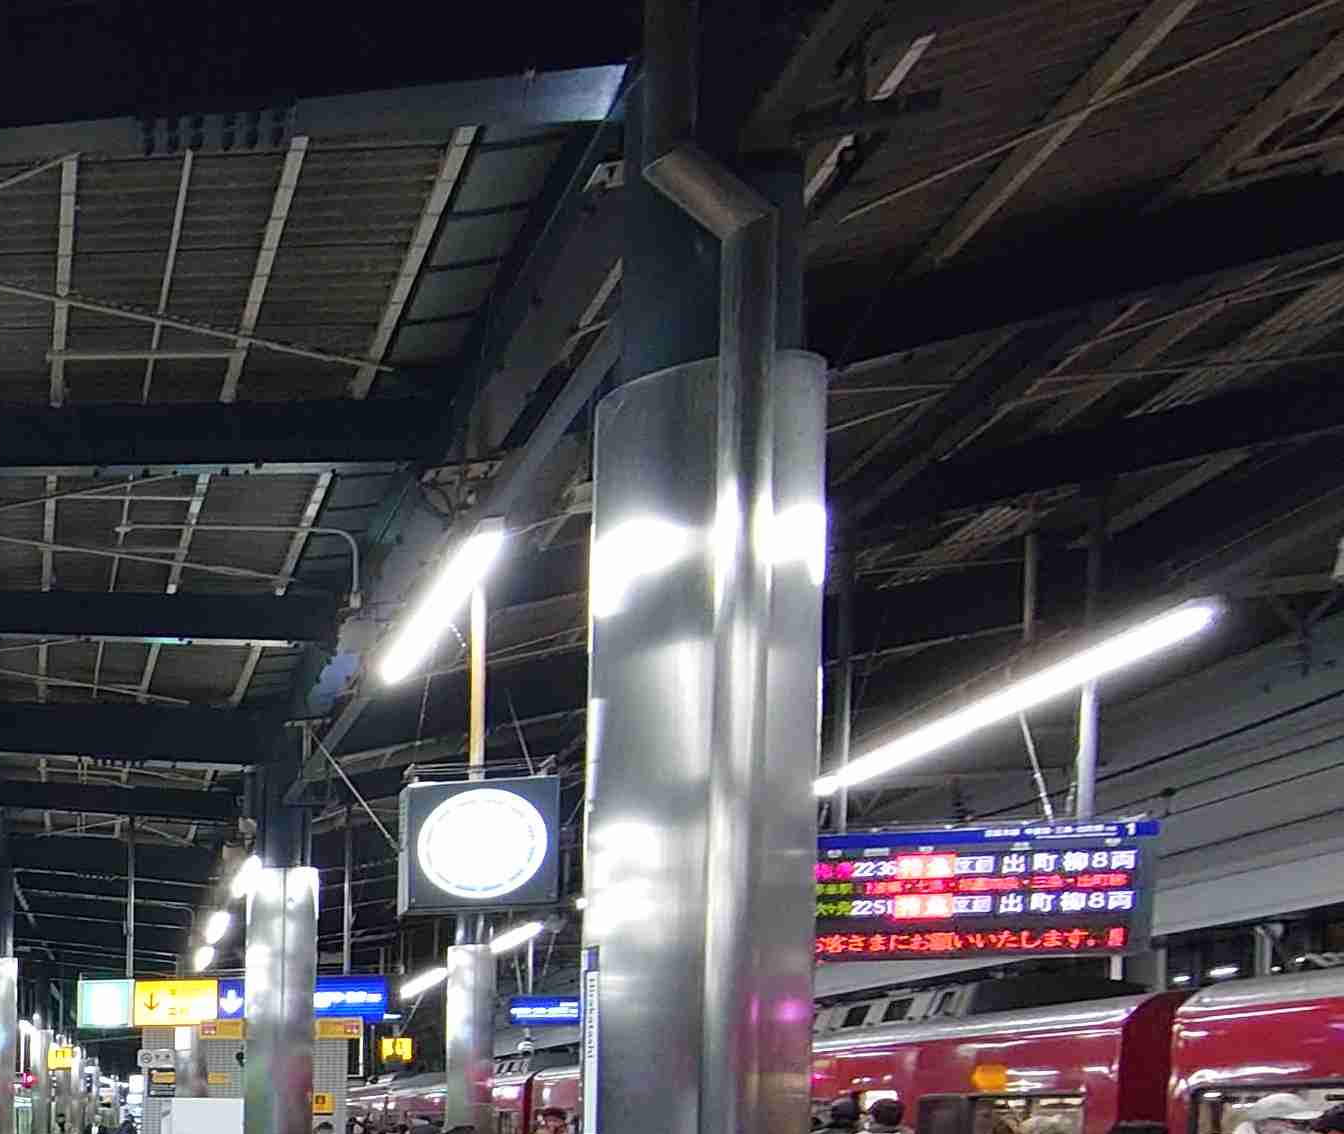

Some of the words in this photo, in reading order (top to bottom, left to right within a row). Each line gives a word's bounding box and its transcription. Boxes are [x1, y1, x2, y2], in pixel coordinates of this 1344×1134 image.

[1001, 852, 1090, 874] 出町柳
[850, 900, 894, 917] 2251
[999, 892, 1087, 914] 出町柳
